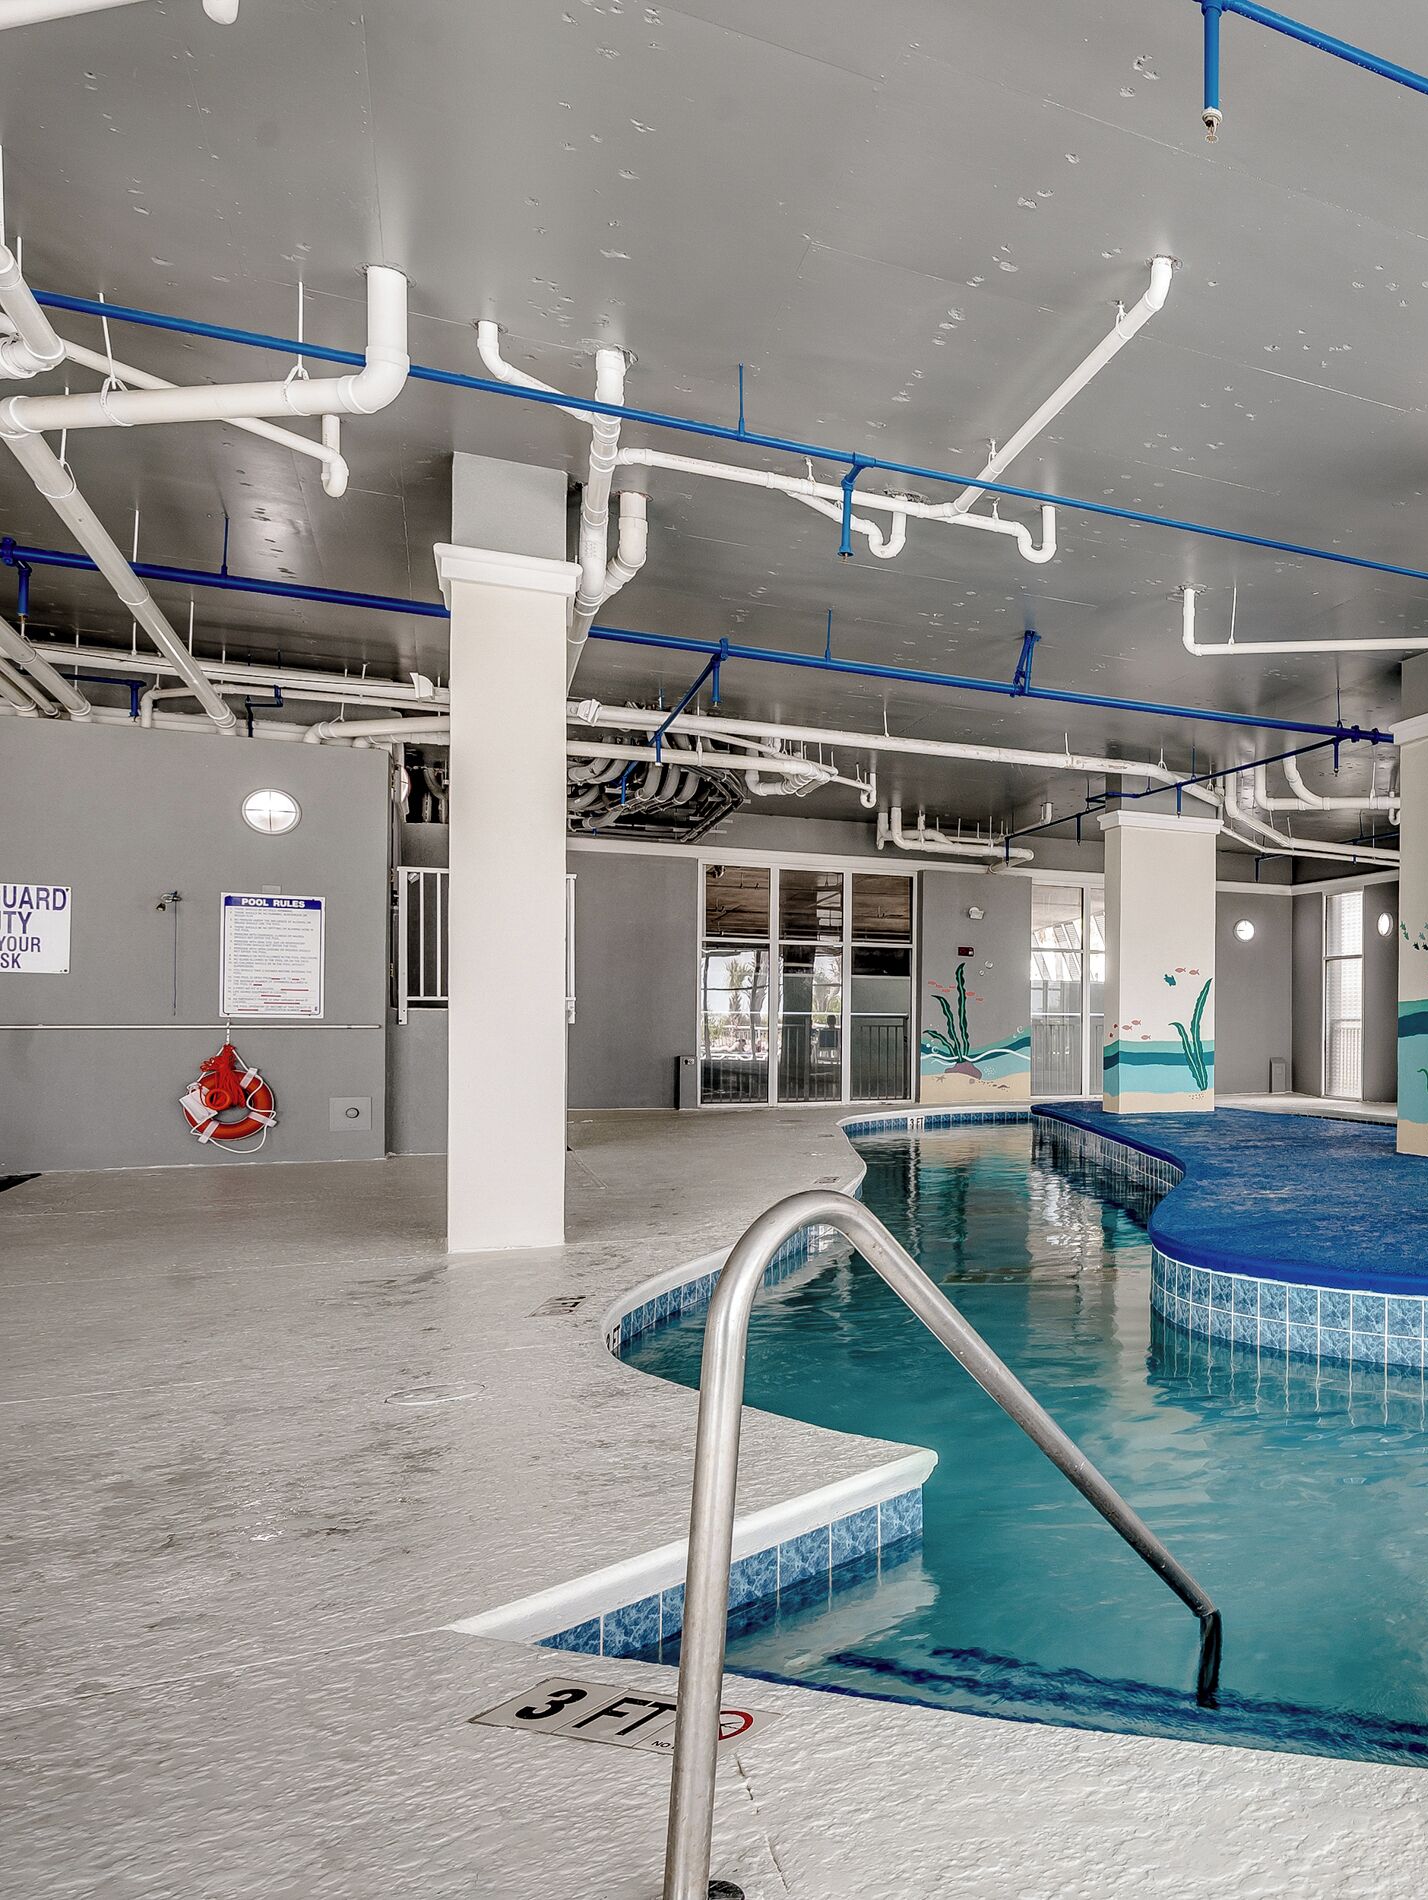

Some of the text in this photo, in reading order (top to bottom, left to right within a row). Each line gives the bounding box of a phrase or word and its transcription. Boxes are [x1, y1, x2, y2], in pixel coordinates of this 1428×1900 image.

[241, 898, 305, 908] POOL RULES
[0, 910, 32, 934] TY
[0, 936, 41, 952] YOUR
[514, 1688, 677, 1736] 3 FT
[651, 1740, 671, 1748] NO
